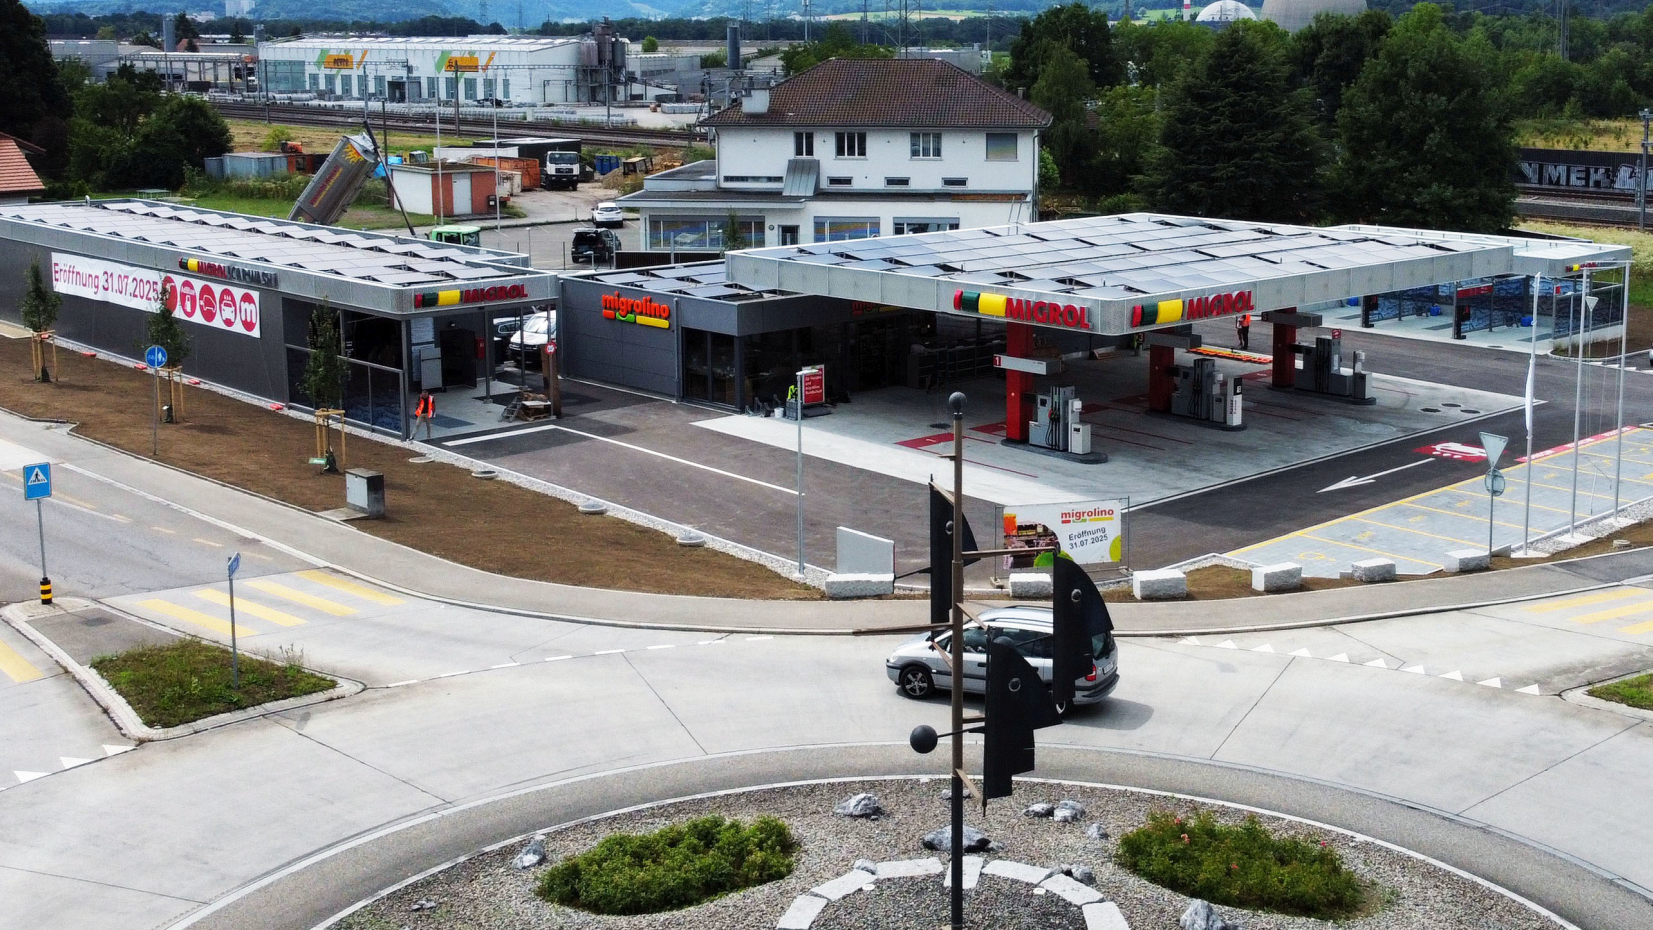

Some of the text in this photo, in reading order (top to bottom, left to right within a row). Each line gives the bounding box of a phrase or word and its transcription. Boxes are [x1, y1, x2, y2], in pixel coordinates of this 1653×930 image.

[53, 262, 160, 303] Eröffnung 31.07.2025
[463, 284, 528, 303] MIGROL
[601, 290, 670, 318] migrolino
[1005, 297, 1090, 329] MIGROL
[1186, 290, 1255, 320] MIGROL
[1060, 507, 1114, 520] migrolino
[1068, 526, 1106, 541] Eröffnung
[1069, 534, 1108, 550] 31.07.2025
